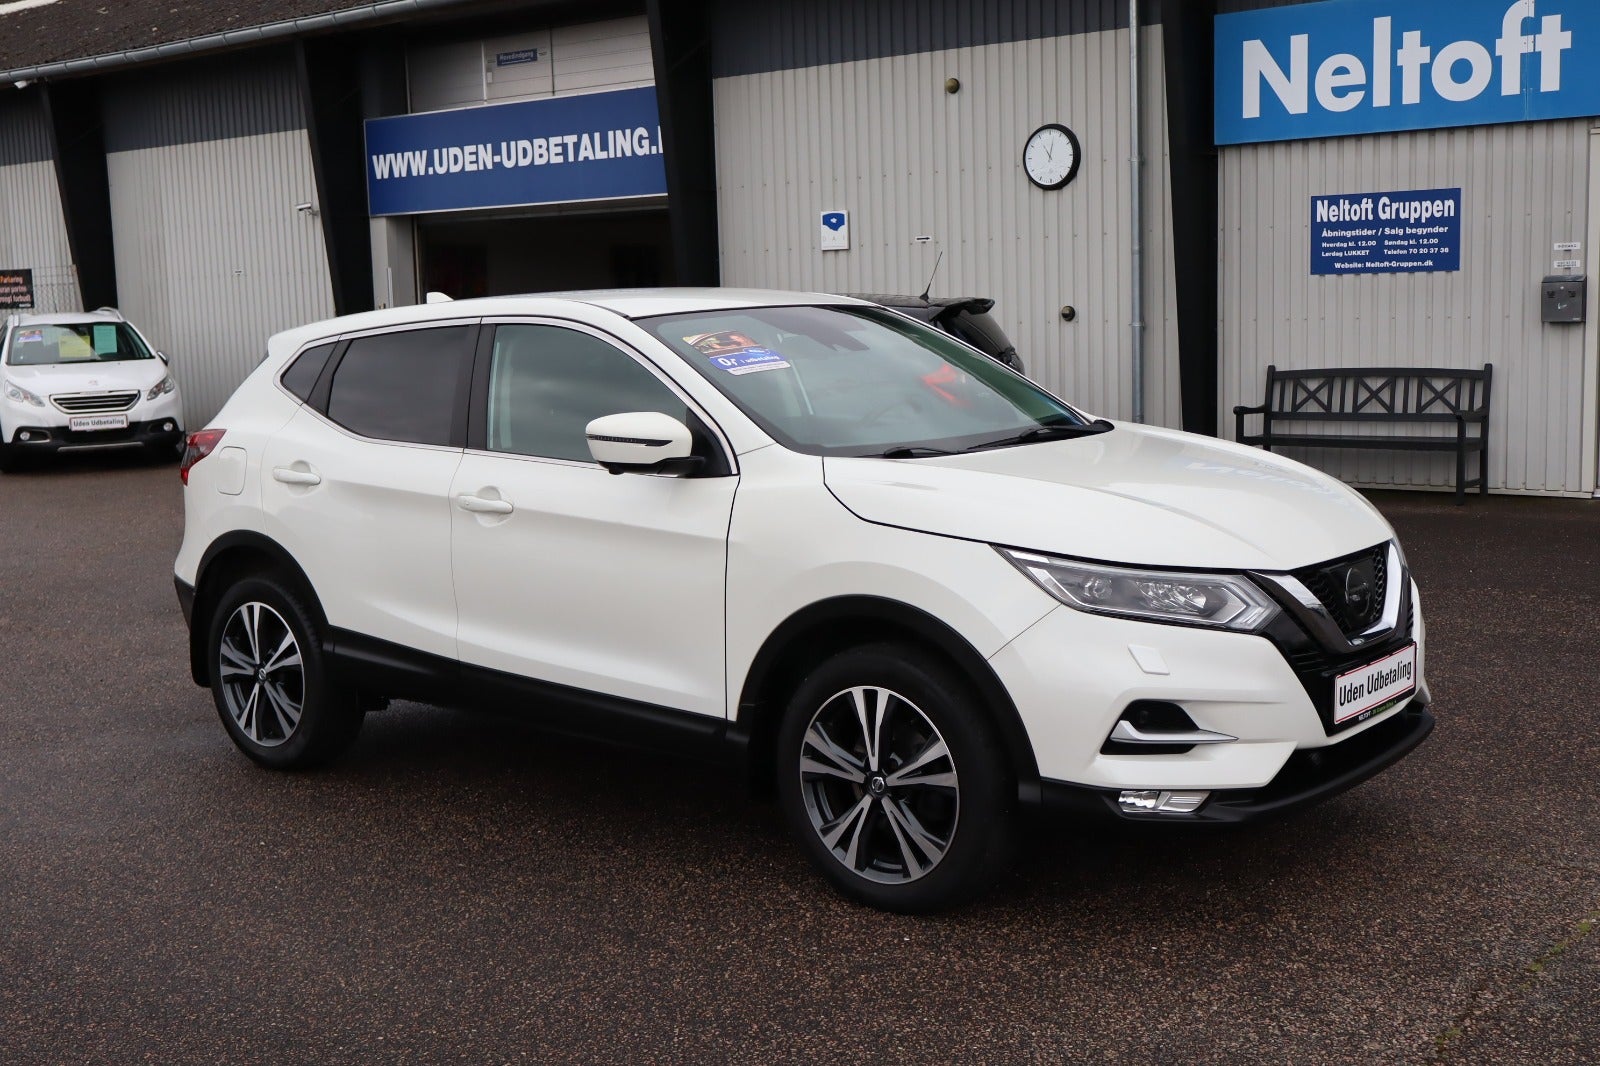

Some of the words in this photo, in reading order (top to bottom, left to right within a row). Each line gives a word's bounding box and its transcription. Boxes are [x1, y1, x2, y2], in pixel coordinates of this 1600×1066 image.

[1243, 0, 1572, 119] Neltoft
[1316, 197, 1374, 223] Neltoft
[1378, 196, 1455, 223] Gruppen
[1321, 227, 1377, 238] Åbningstider
[1384, 226, 1404, 236] Salg
[1405, 225, 1449, 235] begynder
[1344, 249, 1370, 257] LUKKET
[1365, 259, 1434, 268] Neltoft-Gruppen.dk
[73, 419, 90, 428] Uden
[91, 417, 125, 426] Udbetaling
[1339, 682, 1364, 707] Uden
[1367, 660, 1412, 695] Udbetaling
